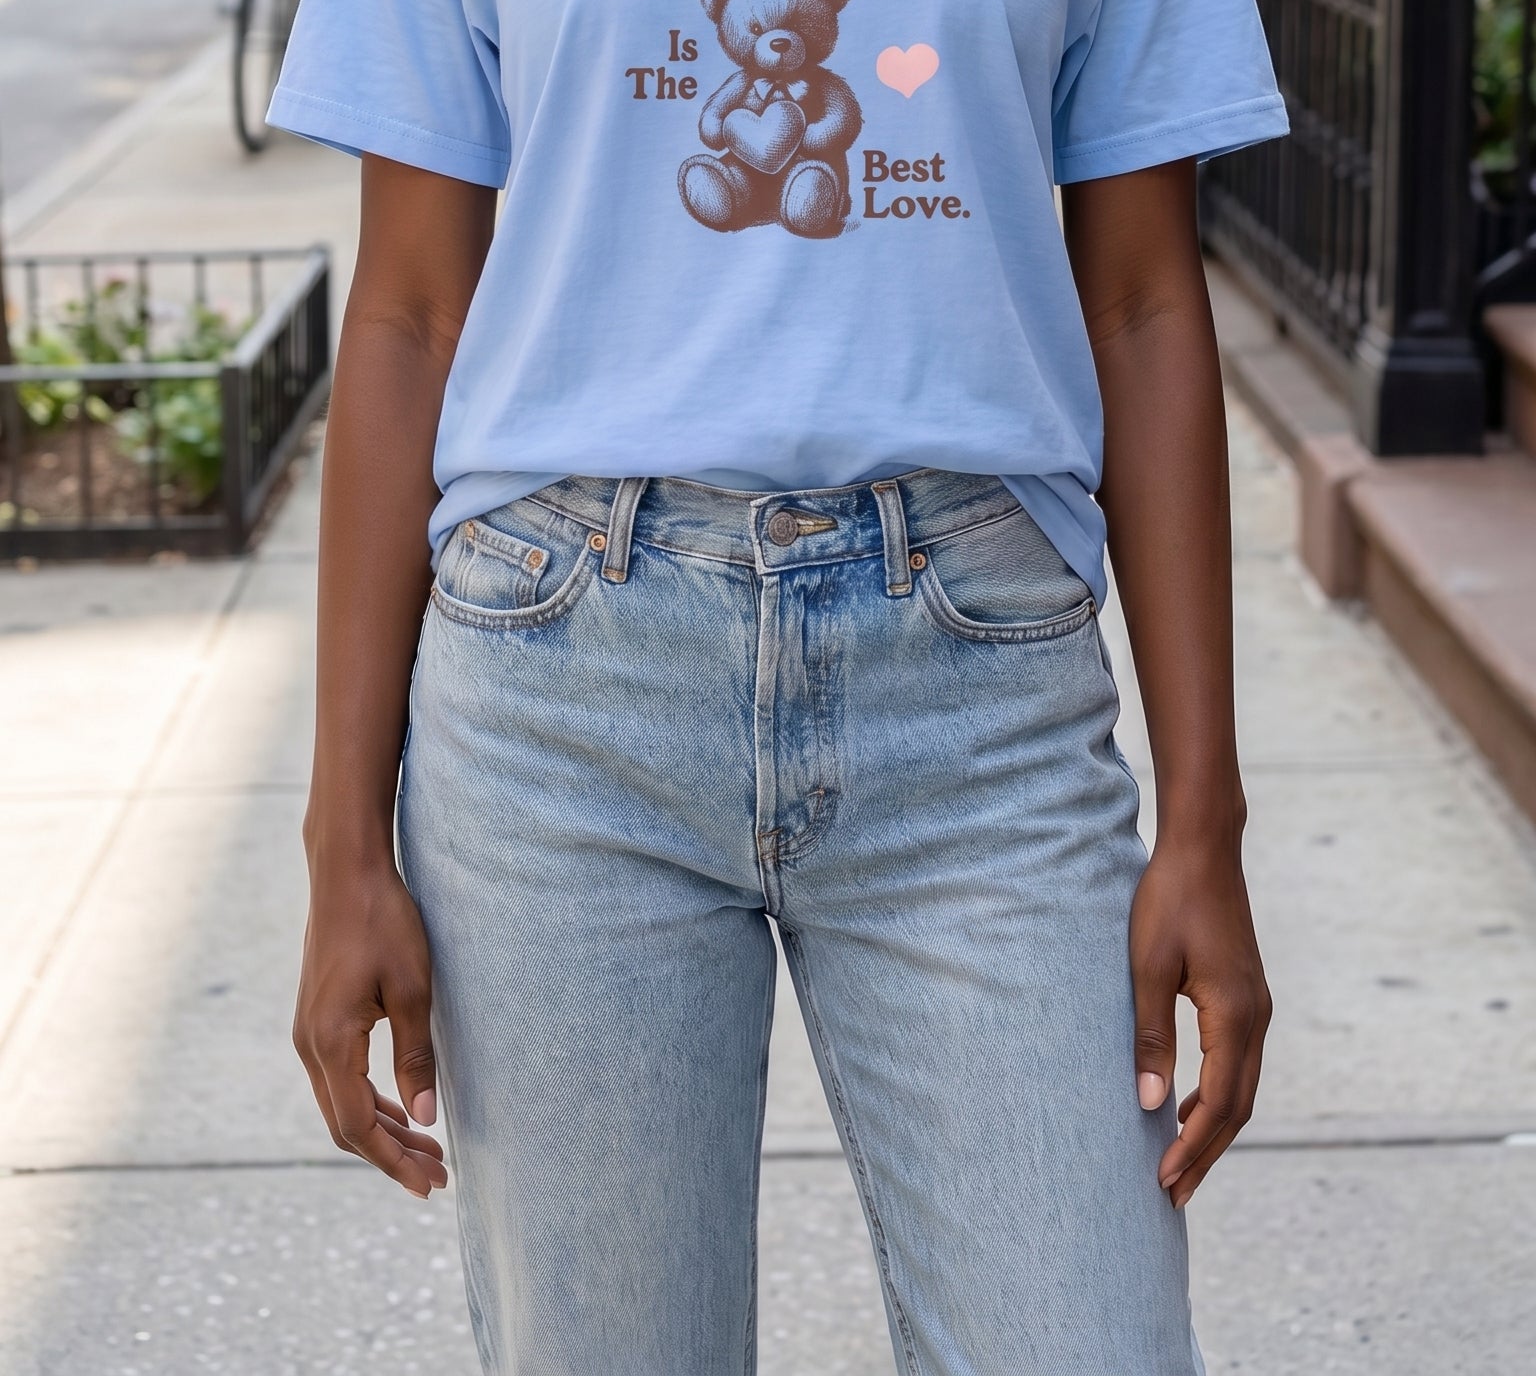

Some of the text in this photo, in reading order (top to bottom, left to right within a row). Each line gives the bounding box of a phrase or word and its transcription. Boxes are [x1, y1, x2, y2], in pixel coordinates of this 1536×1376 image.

[668, 29, 698, 62] Is
[625, 67, 698, 100] The
[862, 150, 945, 183] Best
[863, 187, 971, 219] Love.
